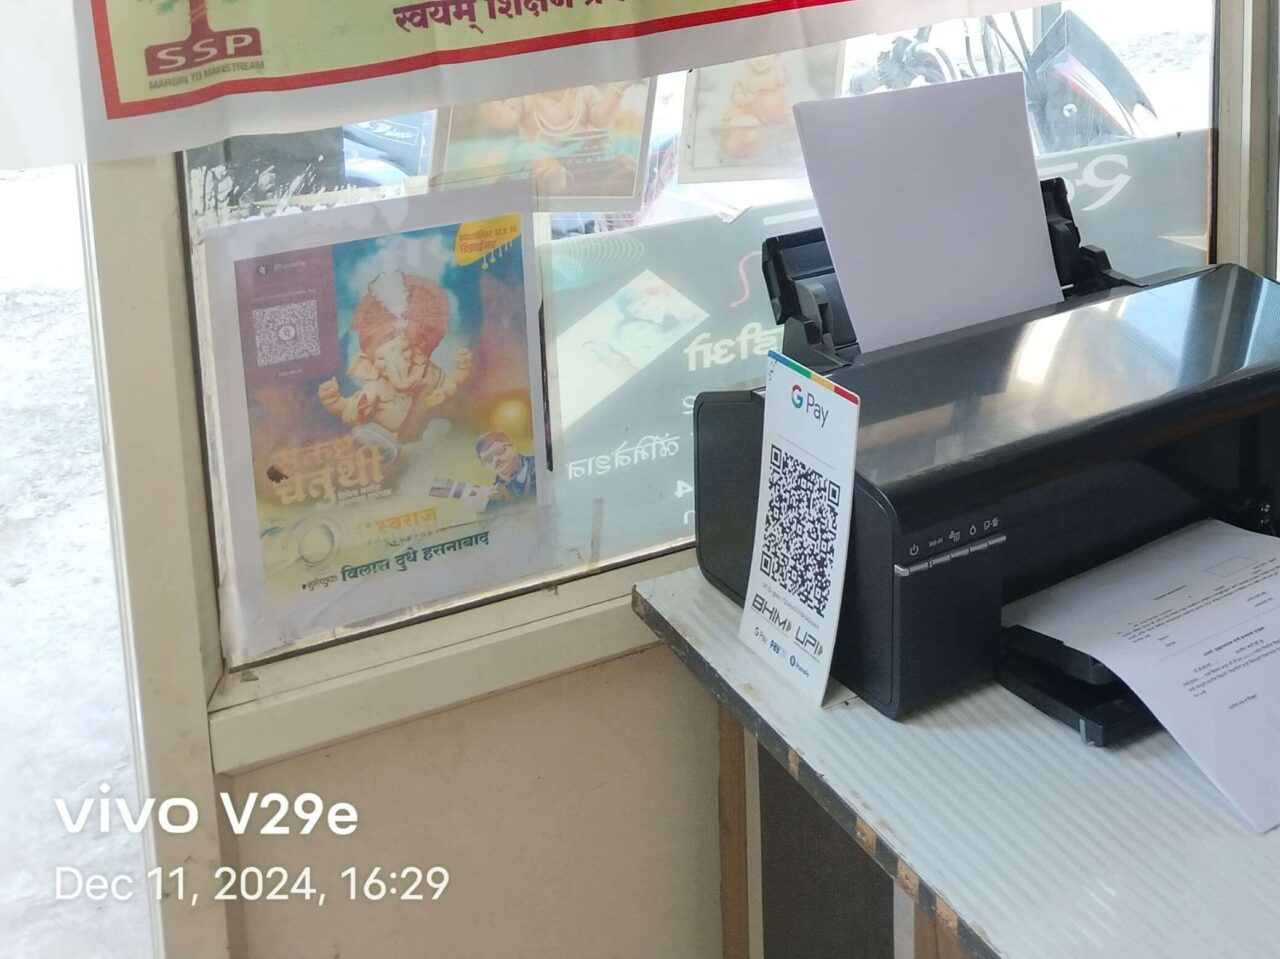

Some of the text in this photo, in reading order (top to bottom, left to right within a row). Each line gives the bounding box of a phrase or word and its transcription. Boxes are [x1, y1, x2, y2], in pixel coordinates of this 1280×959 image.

[157, 34, 253, 69] SSP
[149, 60, 264, 90] MARGIN TO MAINSTREAM
[807, 392, 829, 428] Pay
[340, 557, 390, 582] विलास
[395, 547, 417, 572] दुधे
[422, 531, 490, 561] हसनाबाद
[752, 593, 788, 631] BHIM
[795, 626, 820, 655] UPI
